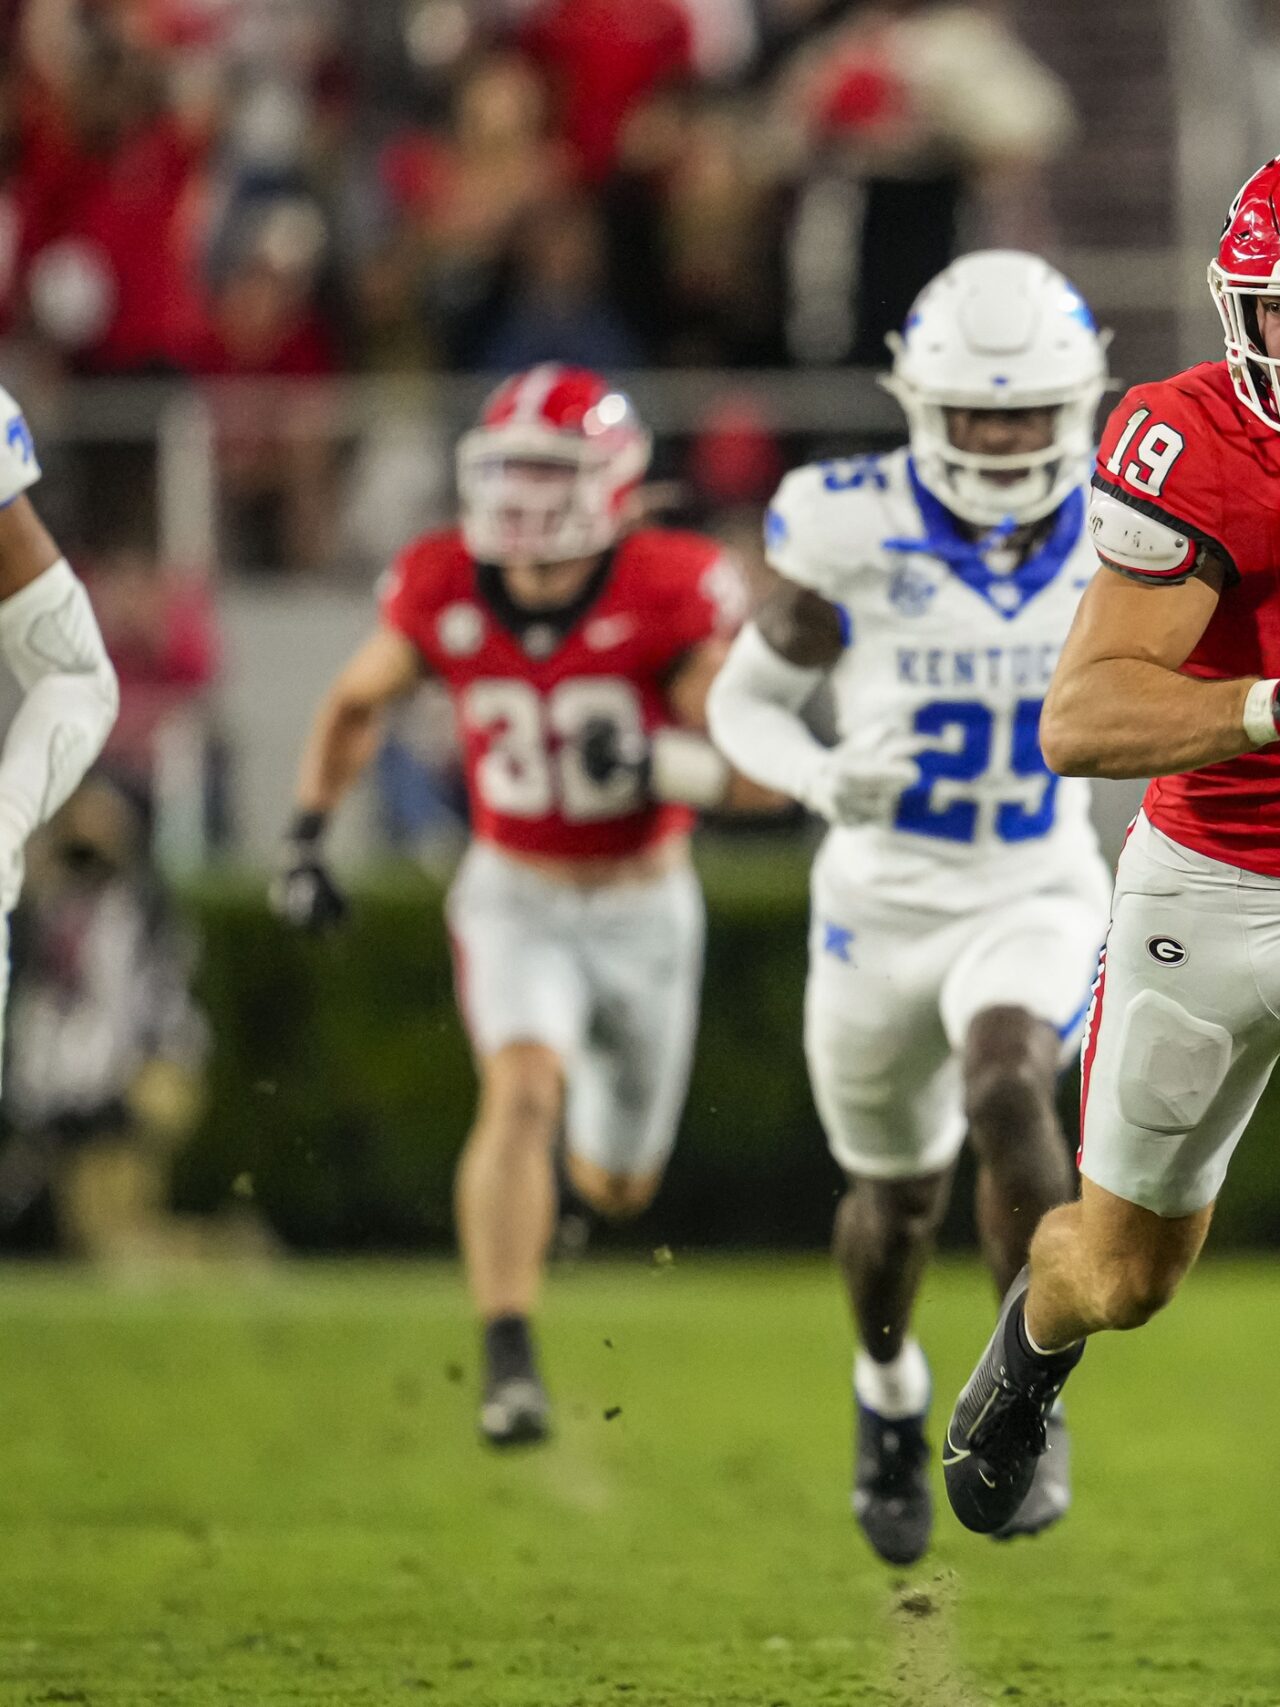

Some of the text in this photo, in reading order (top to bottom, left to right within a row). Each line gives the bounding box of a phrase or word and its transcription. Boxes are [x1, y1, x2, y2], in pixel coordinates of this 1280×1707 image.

[1106, 407, 1186, 498] 19
[895, 647, 1061, 686] KENTUC
[894, 698, 1060, 843] 25
[1150, 938, 1187, 963] G
